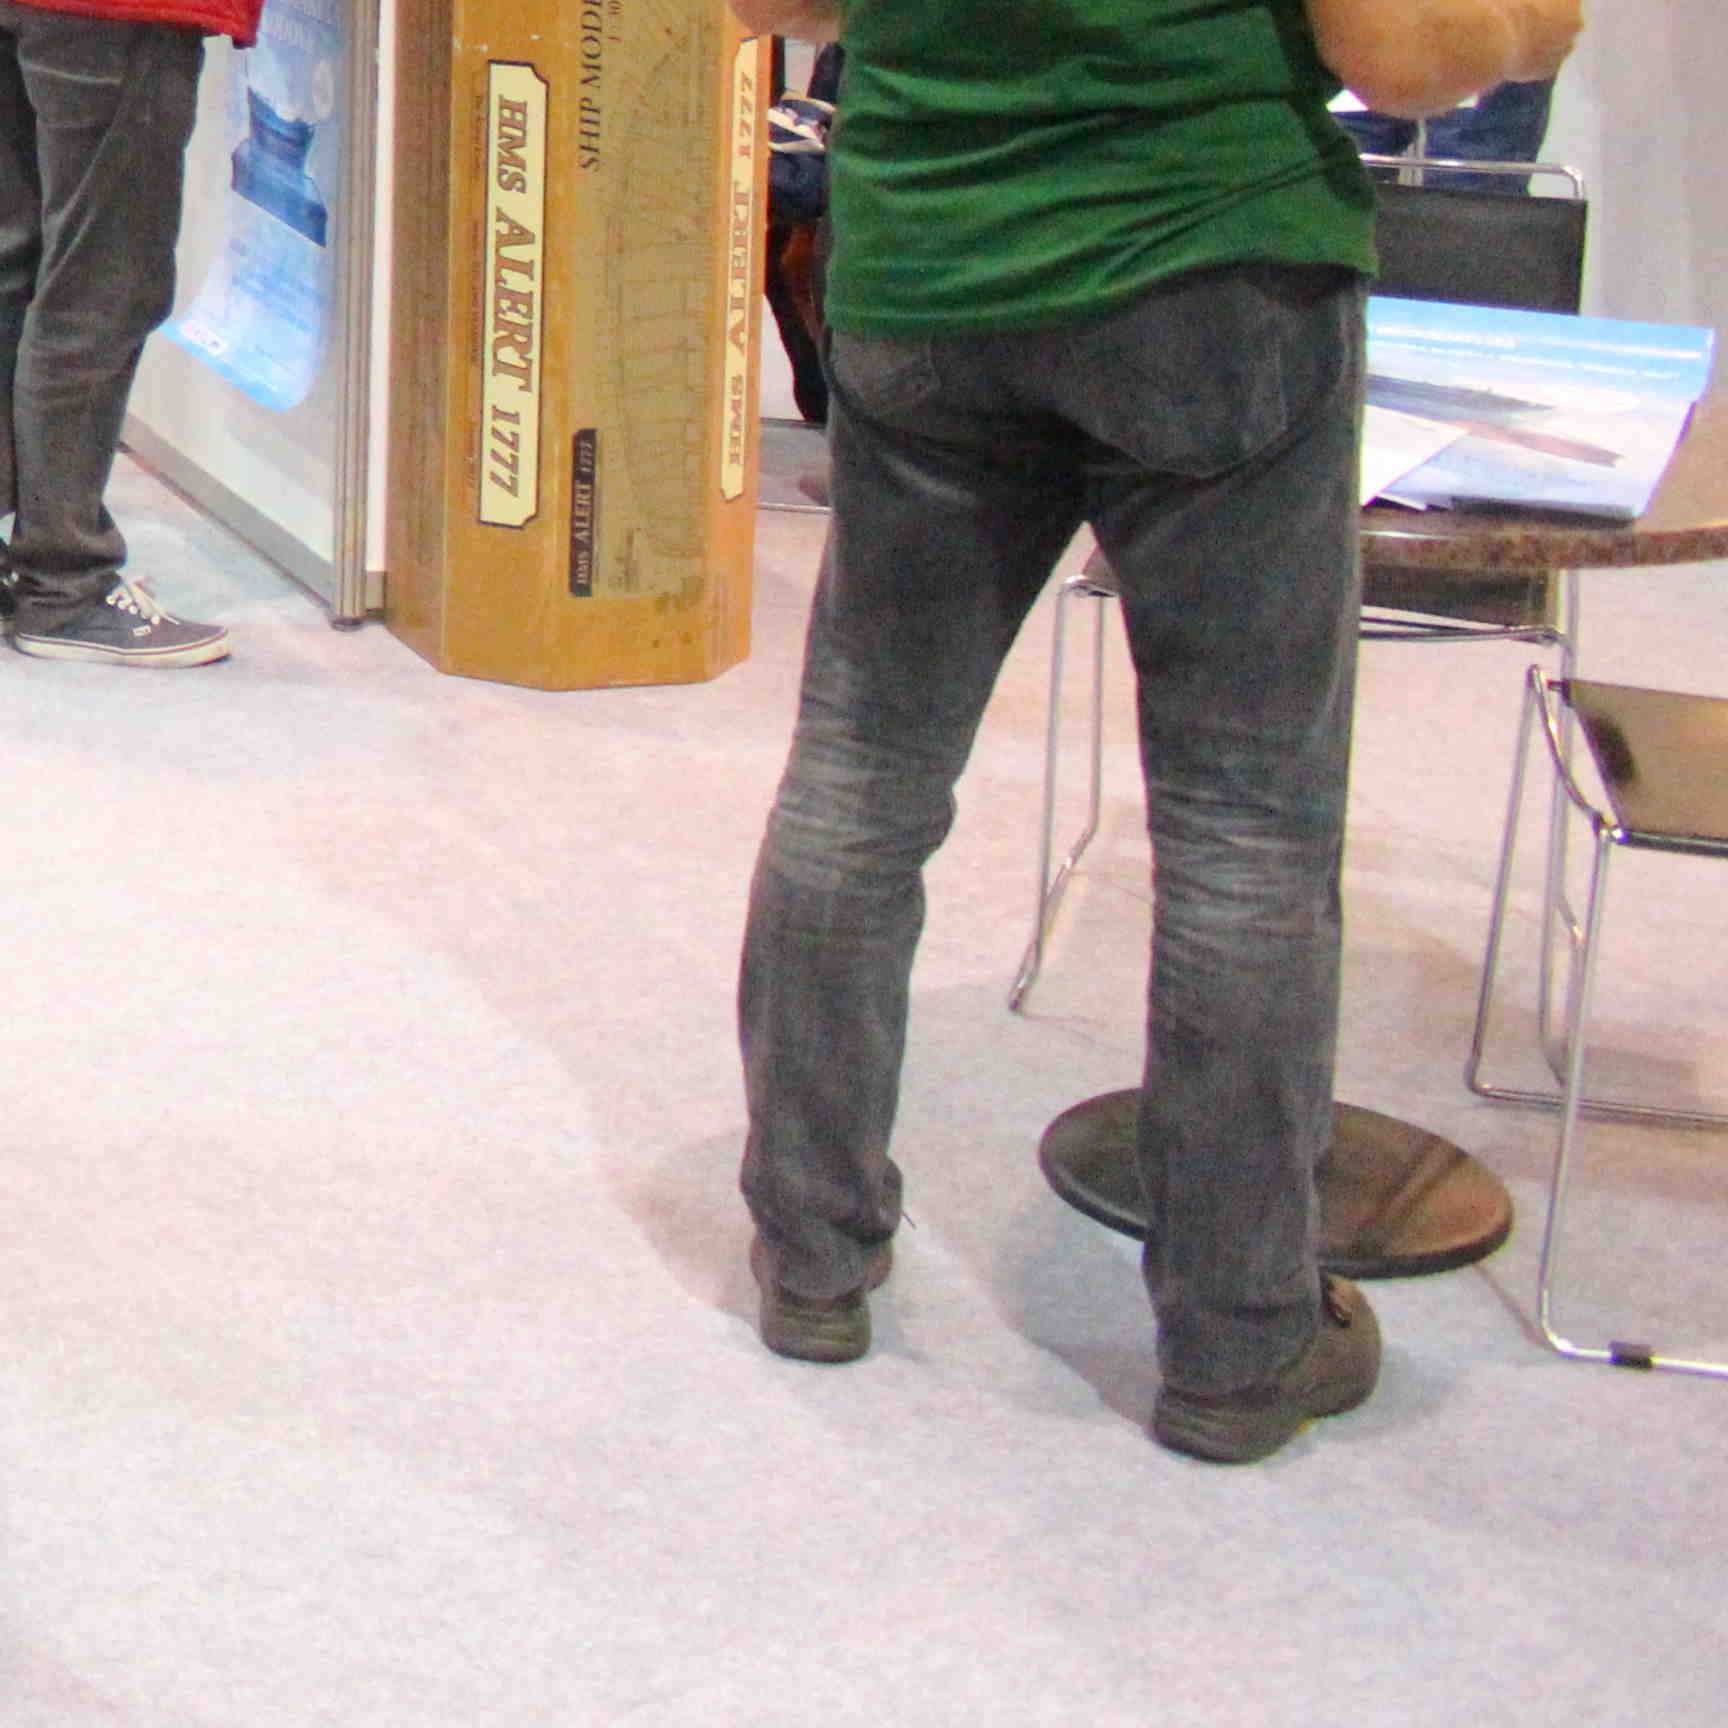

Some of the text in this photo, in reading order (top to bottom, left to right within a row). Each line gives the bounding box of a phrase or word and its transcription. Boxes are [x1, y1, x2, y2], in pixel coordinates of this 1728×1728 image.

[577, 95, 601, 172] SHIP
[489, 93, 537, 498] HMS ALERT 1777
[728, 72, 753, 465] HMS ALERT 1777
[574, 480, 593, 544] ALERT
